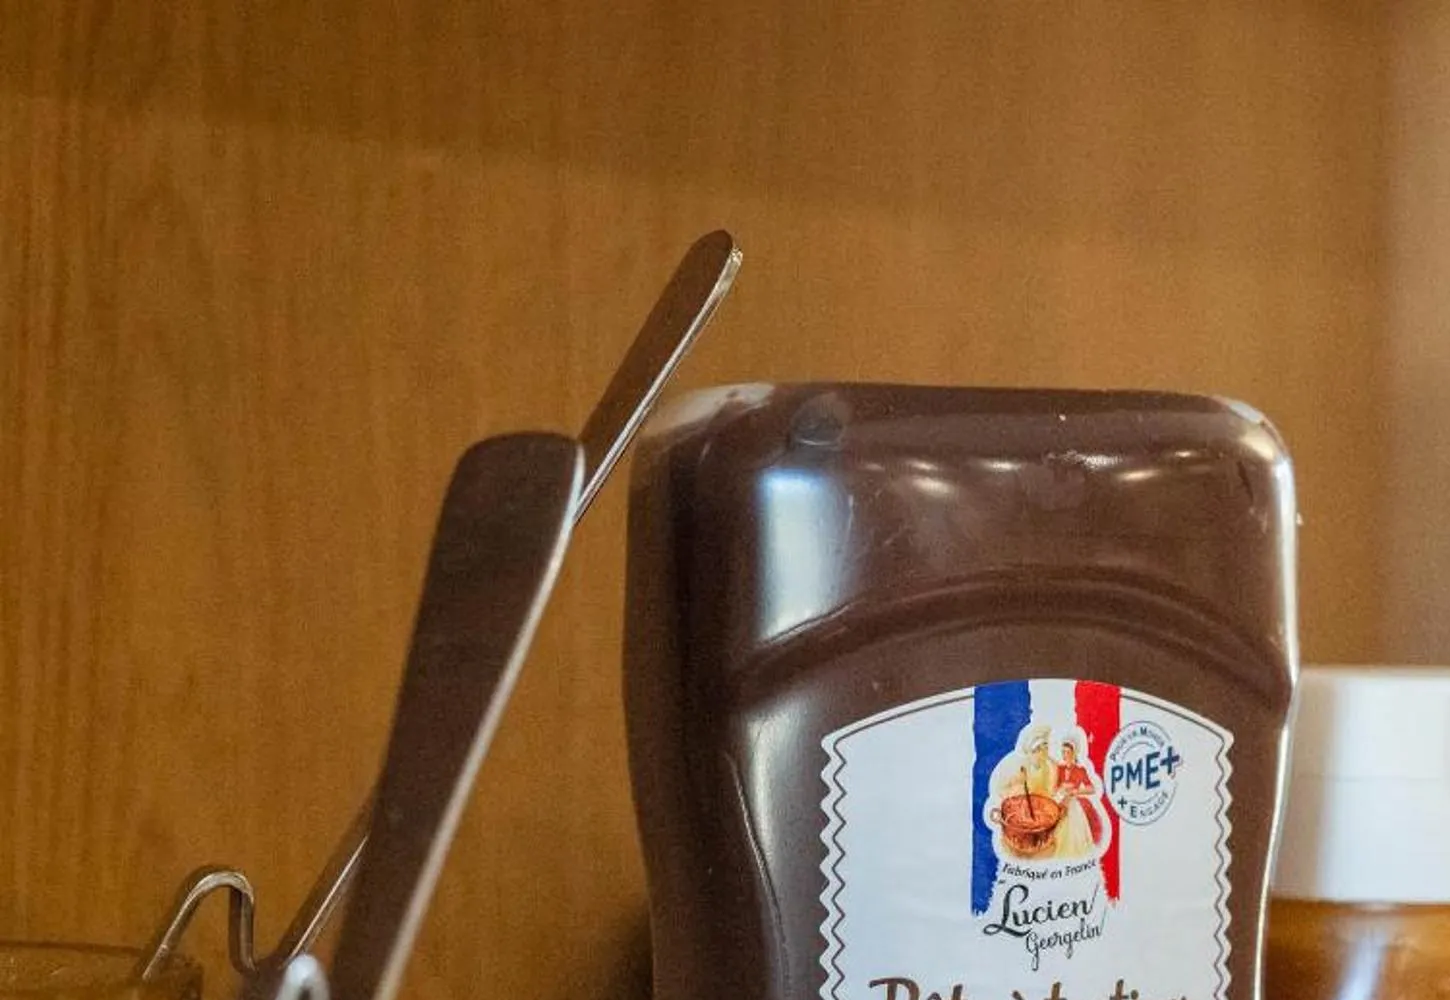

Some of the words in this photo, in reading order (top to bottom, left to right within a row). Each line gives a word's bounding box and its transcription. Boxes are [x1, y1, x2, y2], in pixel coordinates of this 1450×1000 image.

[1111, 746, 1181, 794] PME+
[983, 883, 1098, 937] Lucien
[1025, 917, 1103, 971] Georgelin
